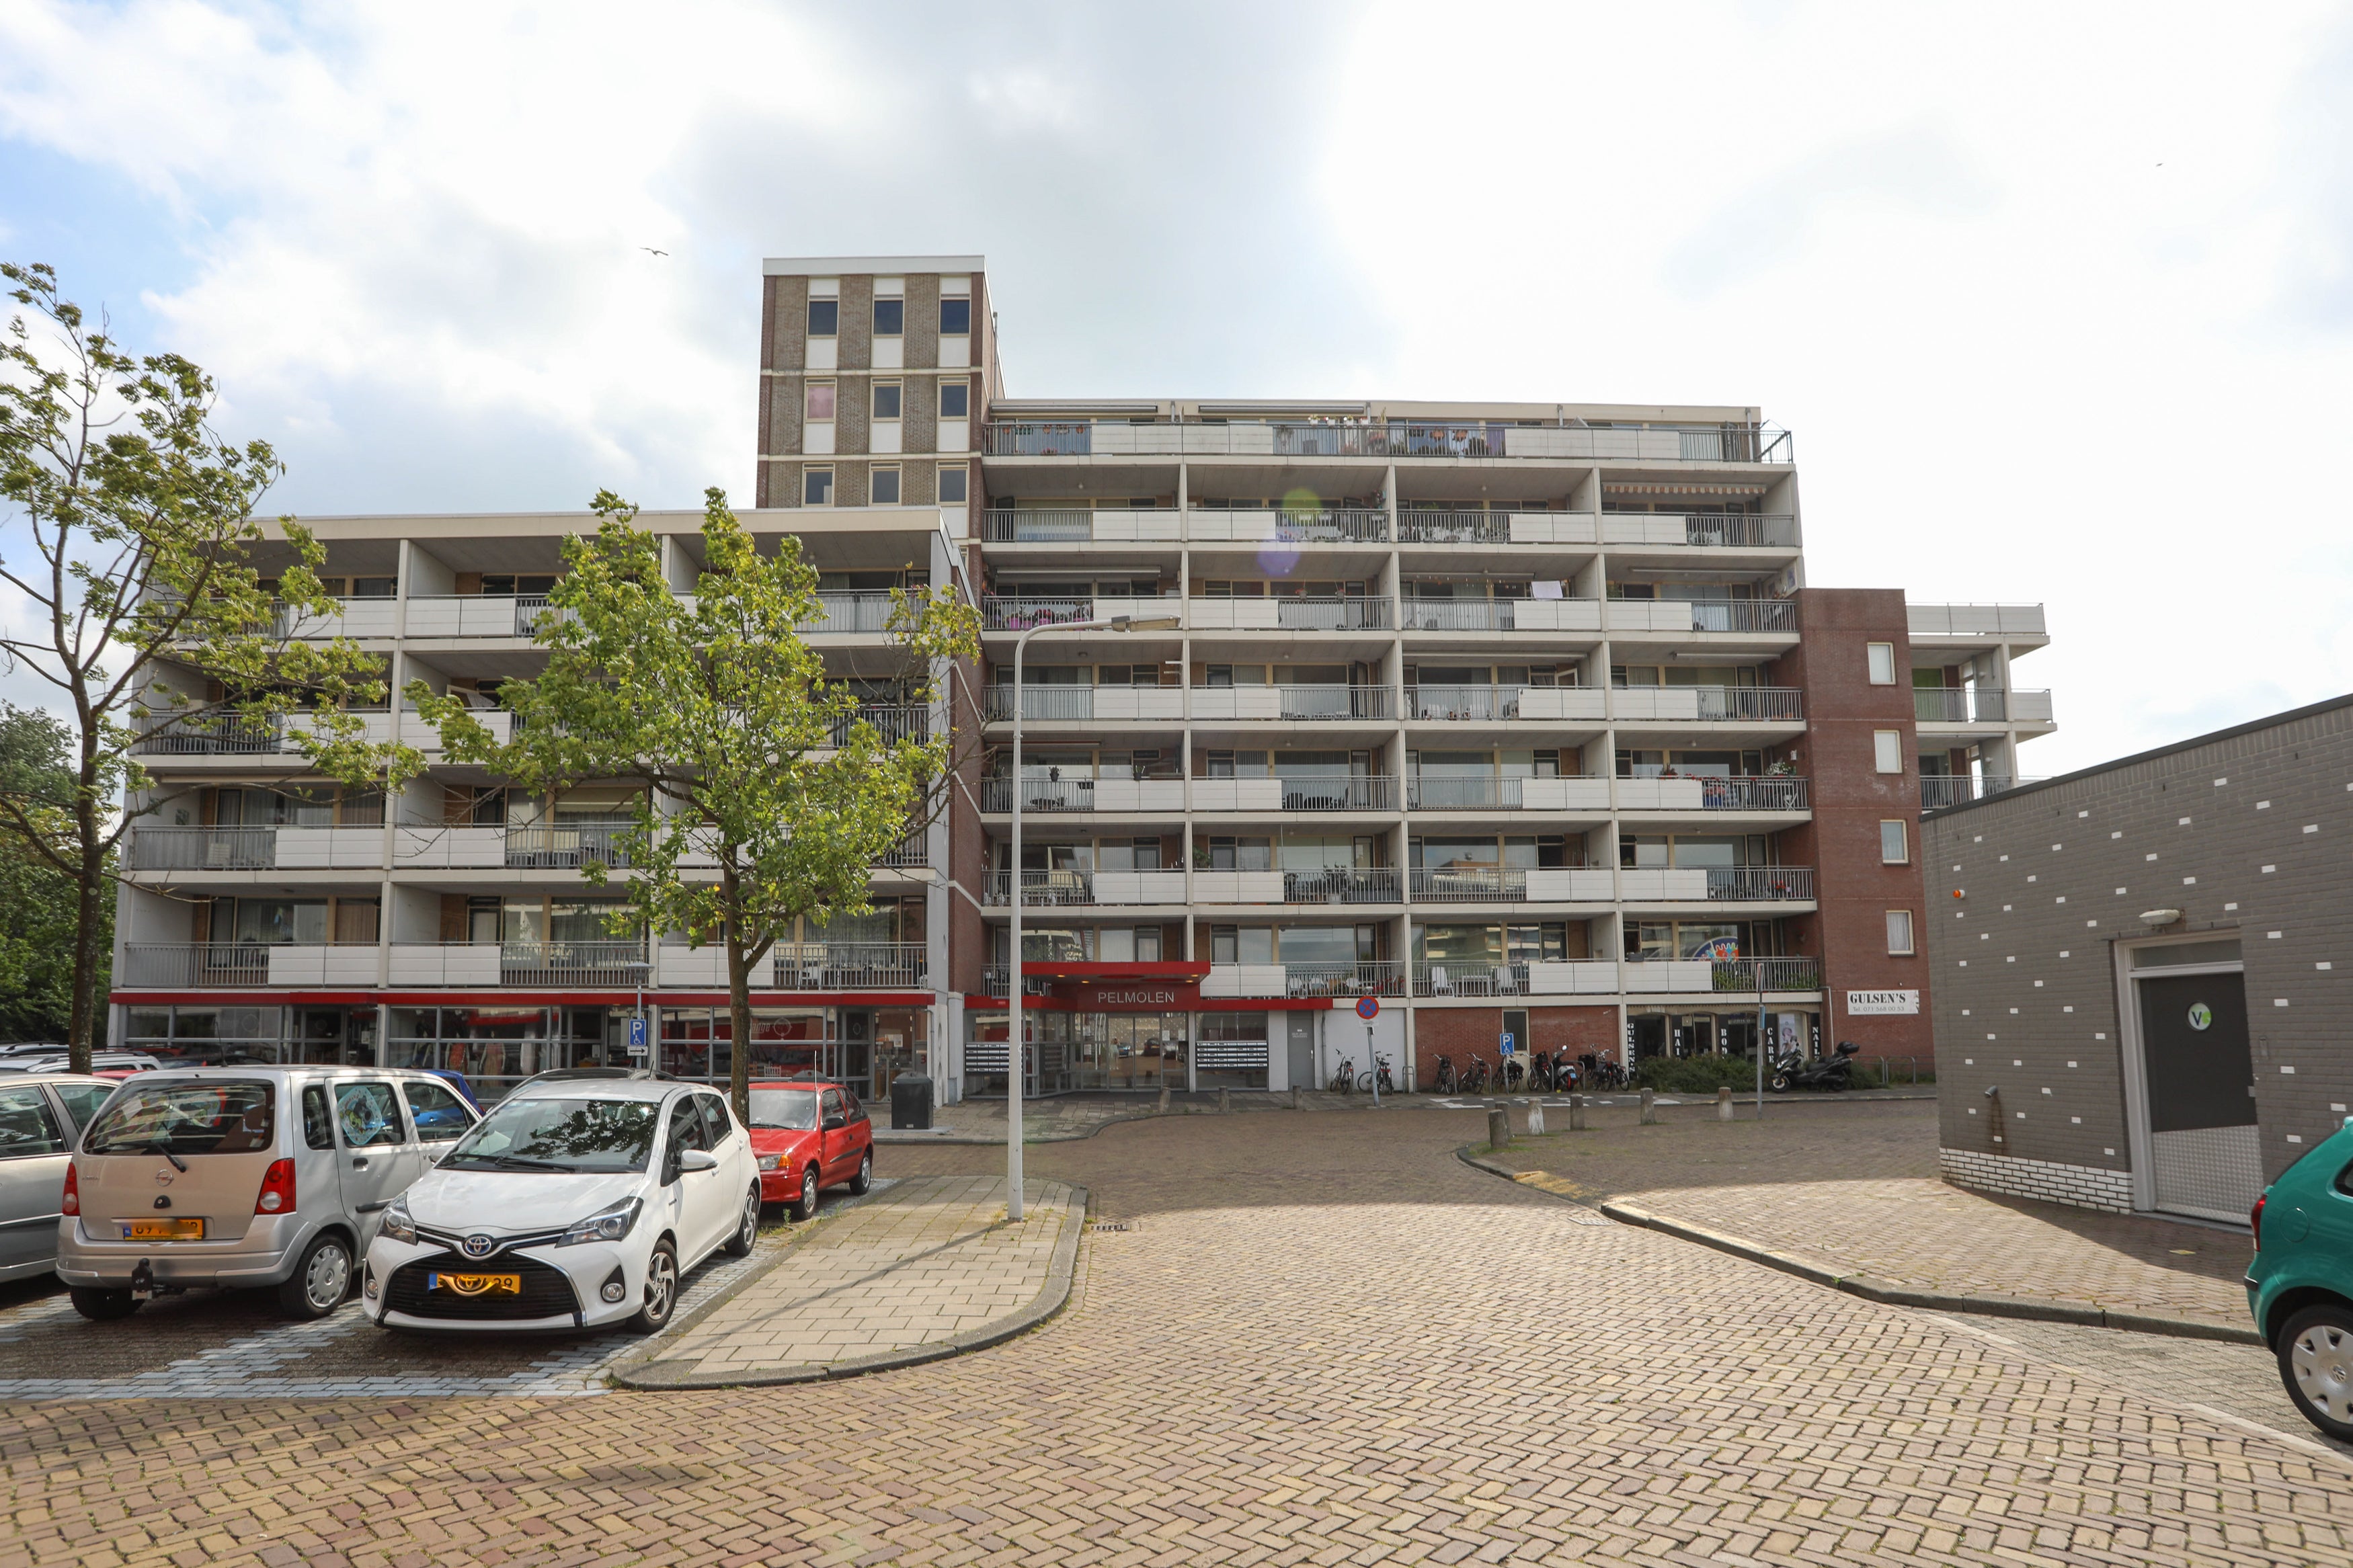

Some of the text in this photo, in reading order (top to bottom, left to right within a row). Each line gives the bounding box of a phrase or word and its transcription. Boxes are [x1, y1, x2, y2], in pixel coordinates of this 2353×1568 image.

[1098, 991, 1174, 1003] PELMOLEN
[1850, 993, 1906, 1004] GULSEN'S
[633, 1022, 643, 1035] P
[1503, 1035, 1511, 1046] P
[1767, 1027, 1775, 1063] CARE
